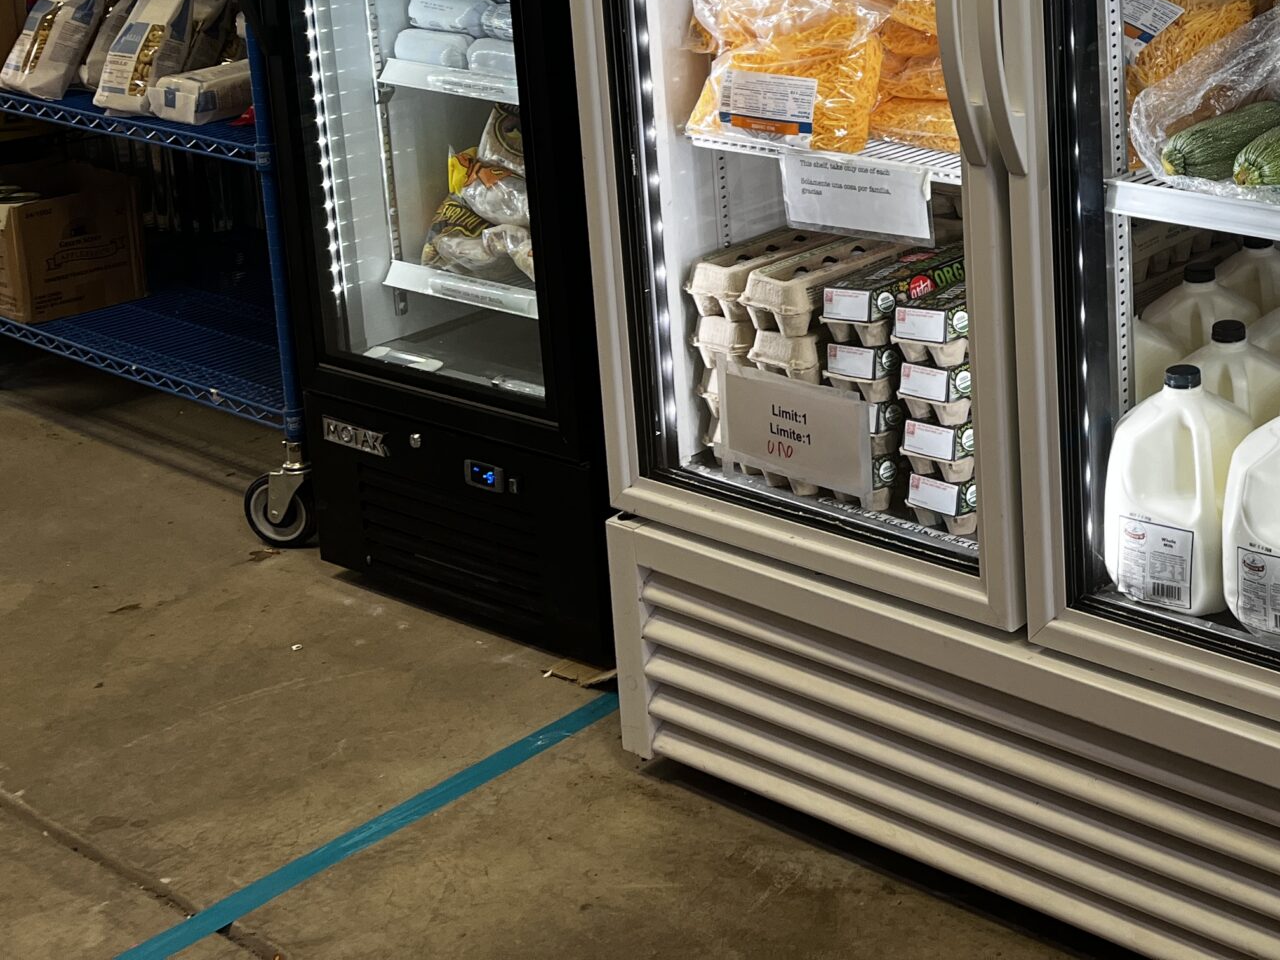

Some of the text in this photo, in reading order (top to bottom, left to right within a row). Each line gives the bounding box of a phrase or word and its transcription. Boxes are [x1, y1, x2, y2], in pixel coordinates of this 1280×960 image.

[800, 159, 812, 167] This
[813, 160, 829, 169] shelf,
[830, 163, 843, 171] take
[844, 165, 857, 173] only
[801, 177, 831, 188] Solamente
[801, 187, 823, 196] gracias
[771, 404, 808, 425] Limit:1
[326, 420, 381, 453] MOTAK
[769, 422, 812, 446] Limite:1
